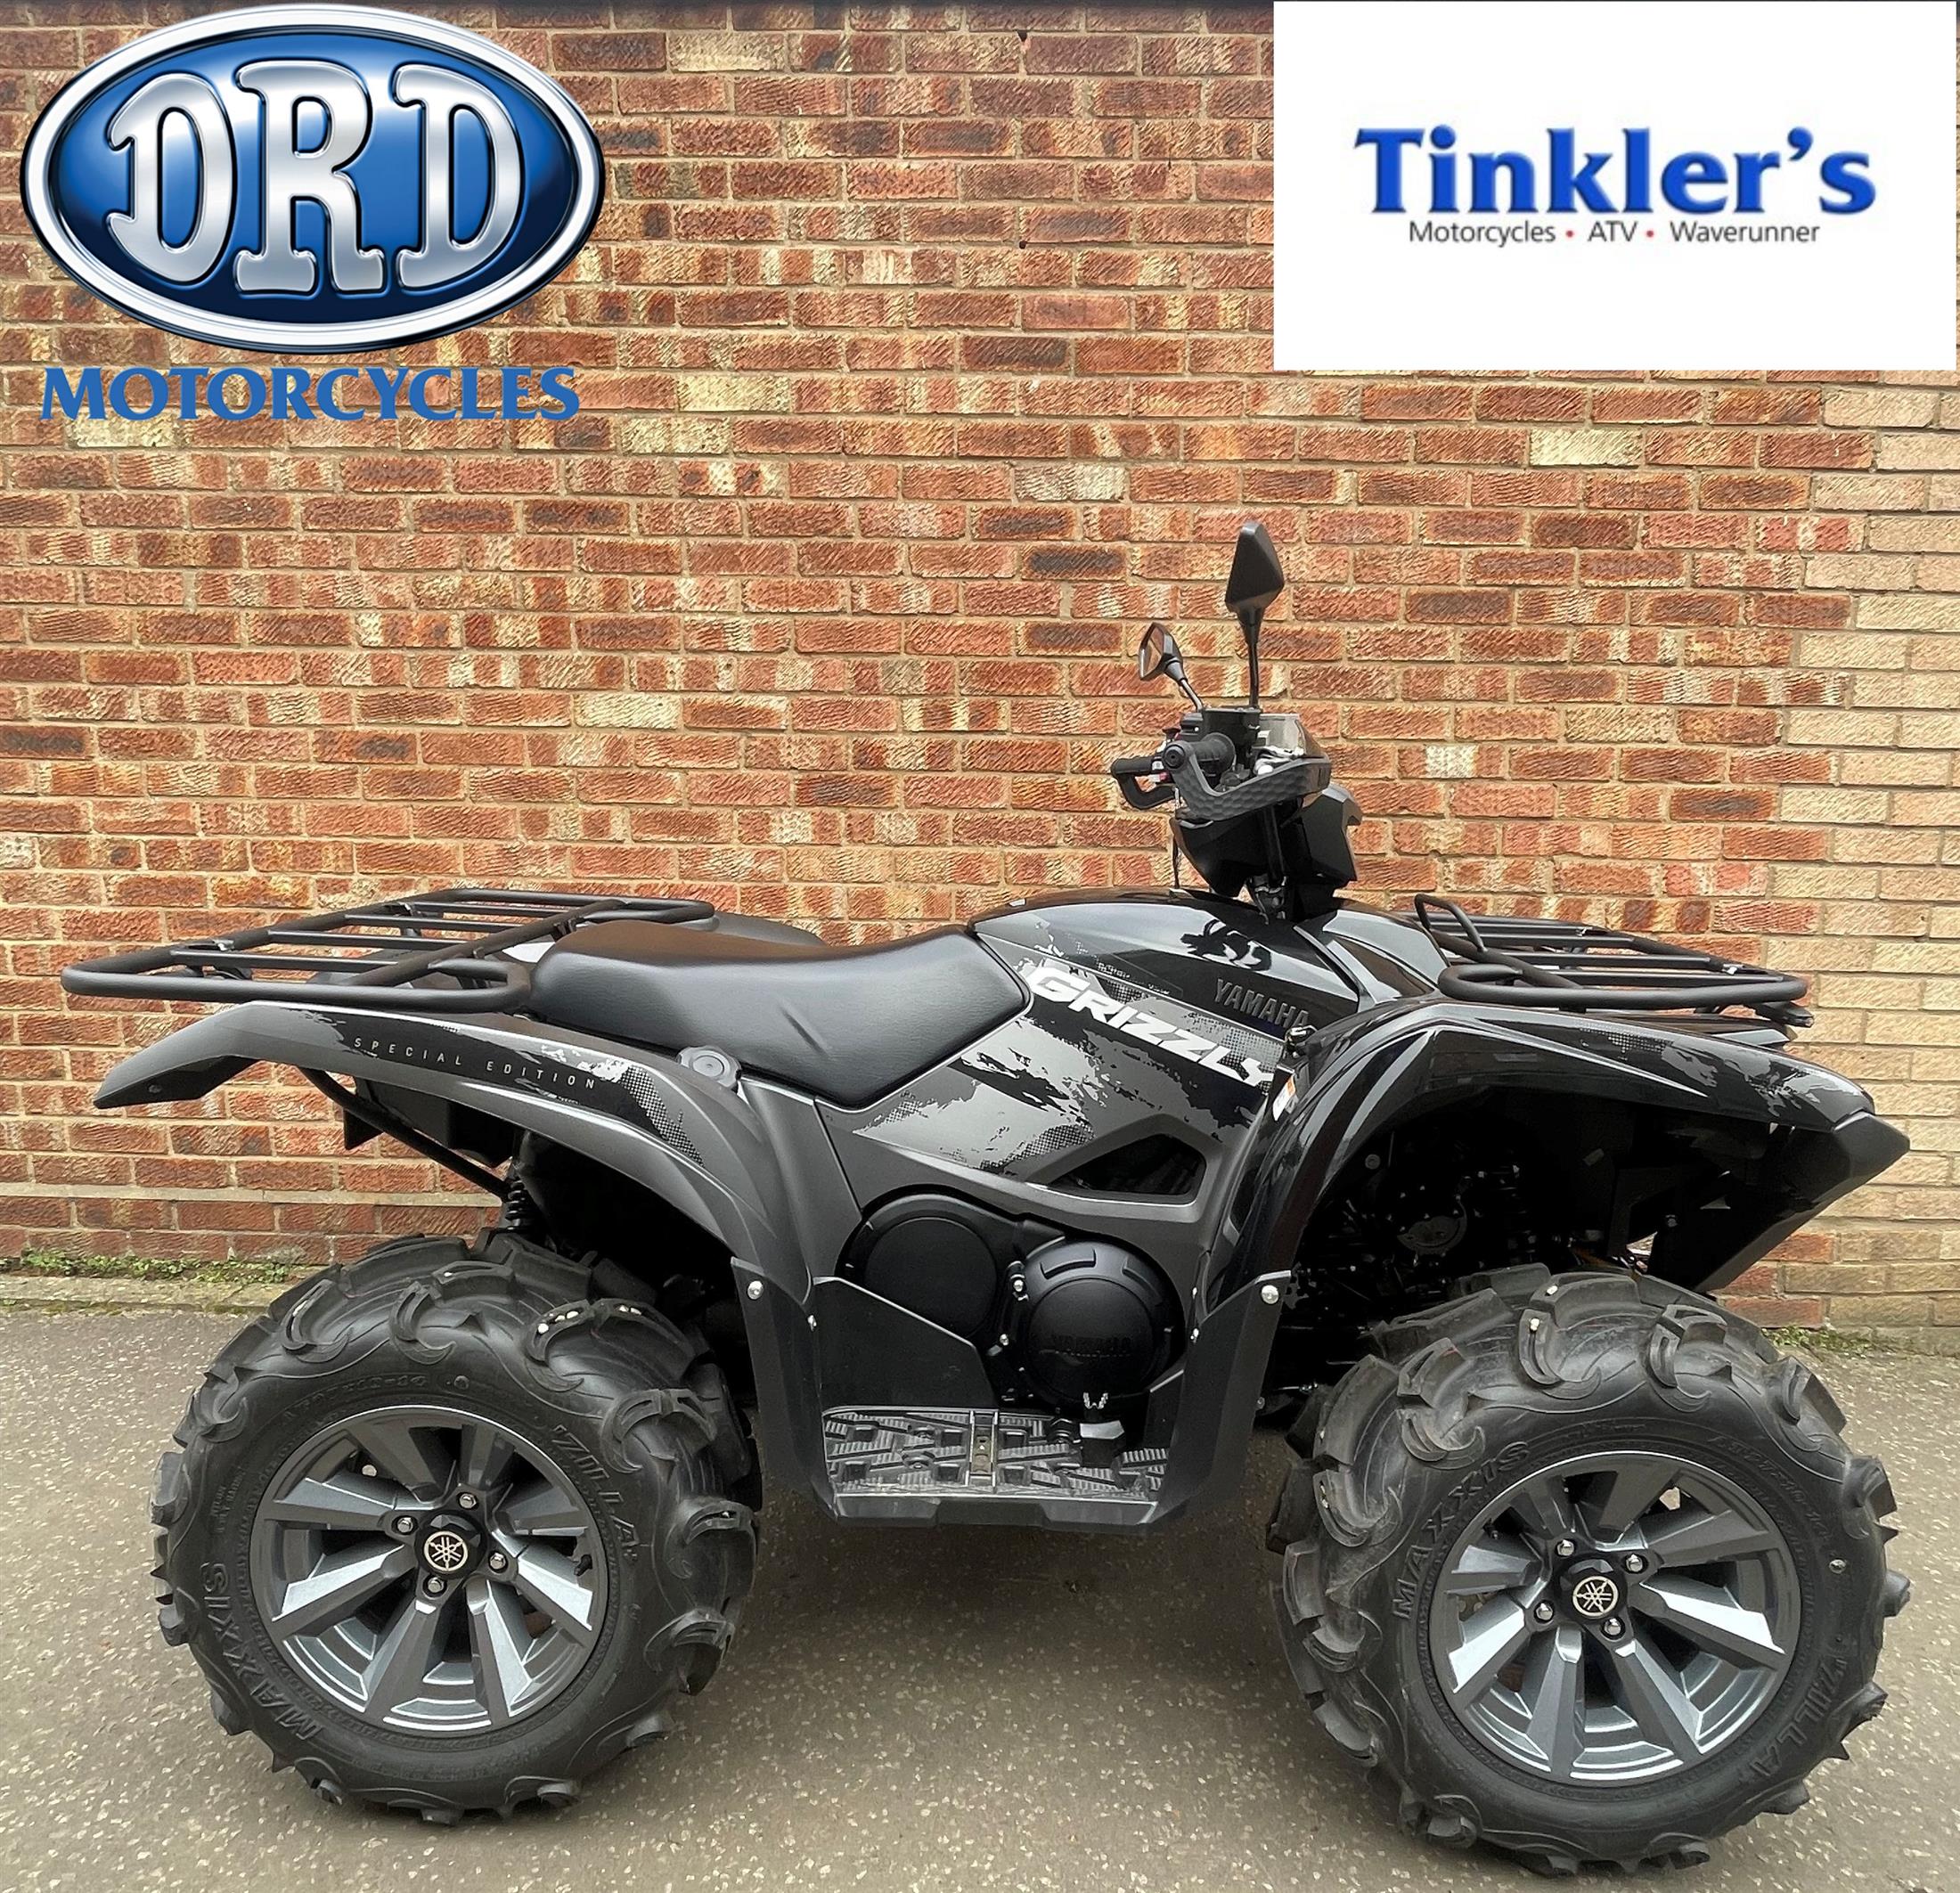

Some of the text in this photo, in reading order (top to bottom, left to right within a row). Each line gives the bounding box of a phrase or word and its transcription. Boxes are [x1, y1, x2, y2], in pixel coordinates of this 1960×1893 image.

[354, 1038, 596, 1089] SPECIAL EDITION
[1026, 967, 1275, 1088] GRIZZLY
[1213, 978, 1311, 1028] YAMAHA
[1392, 1440, 1530, 1620] MAXXIS
[199, 1561, 324, 1741] MAXXIS
